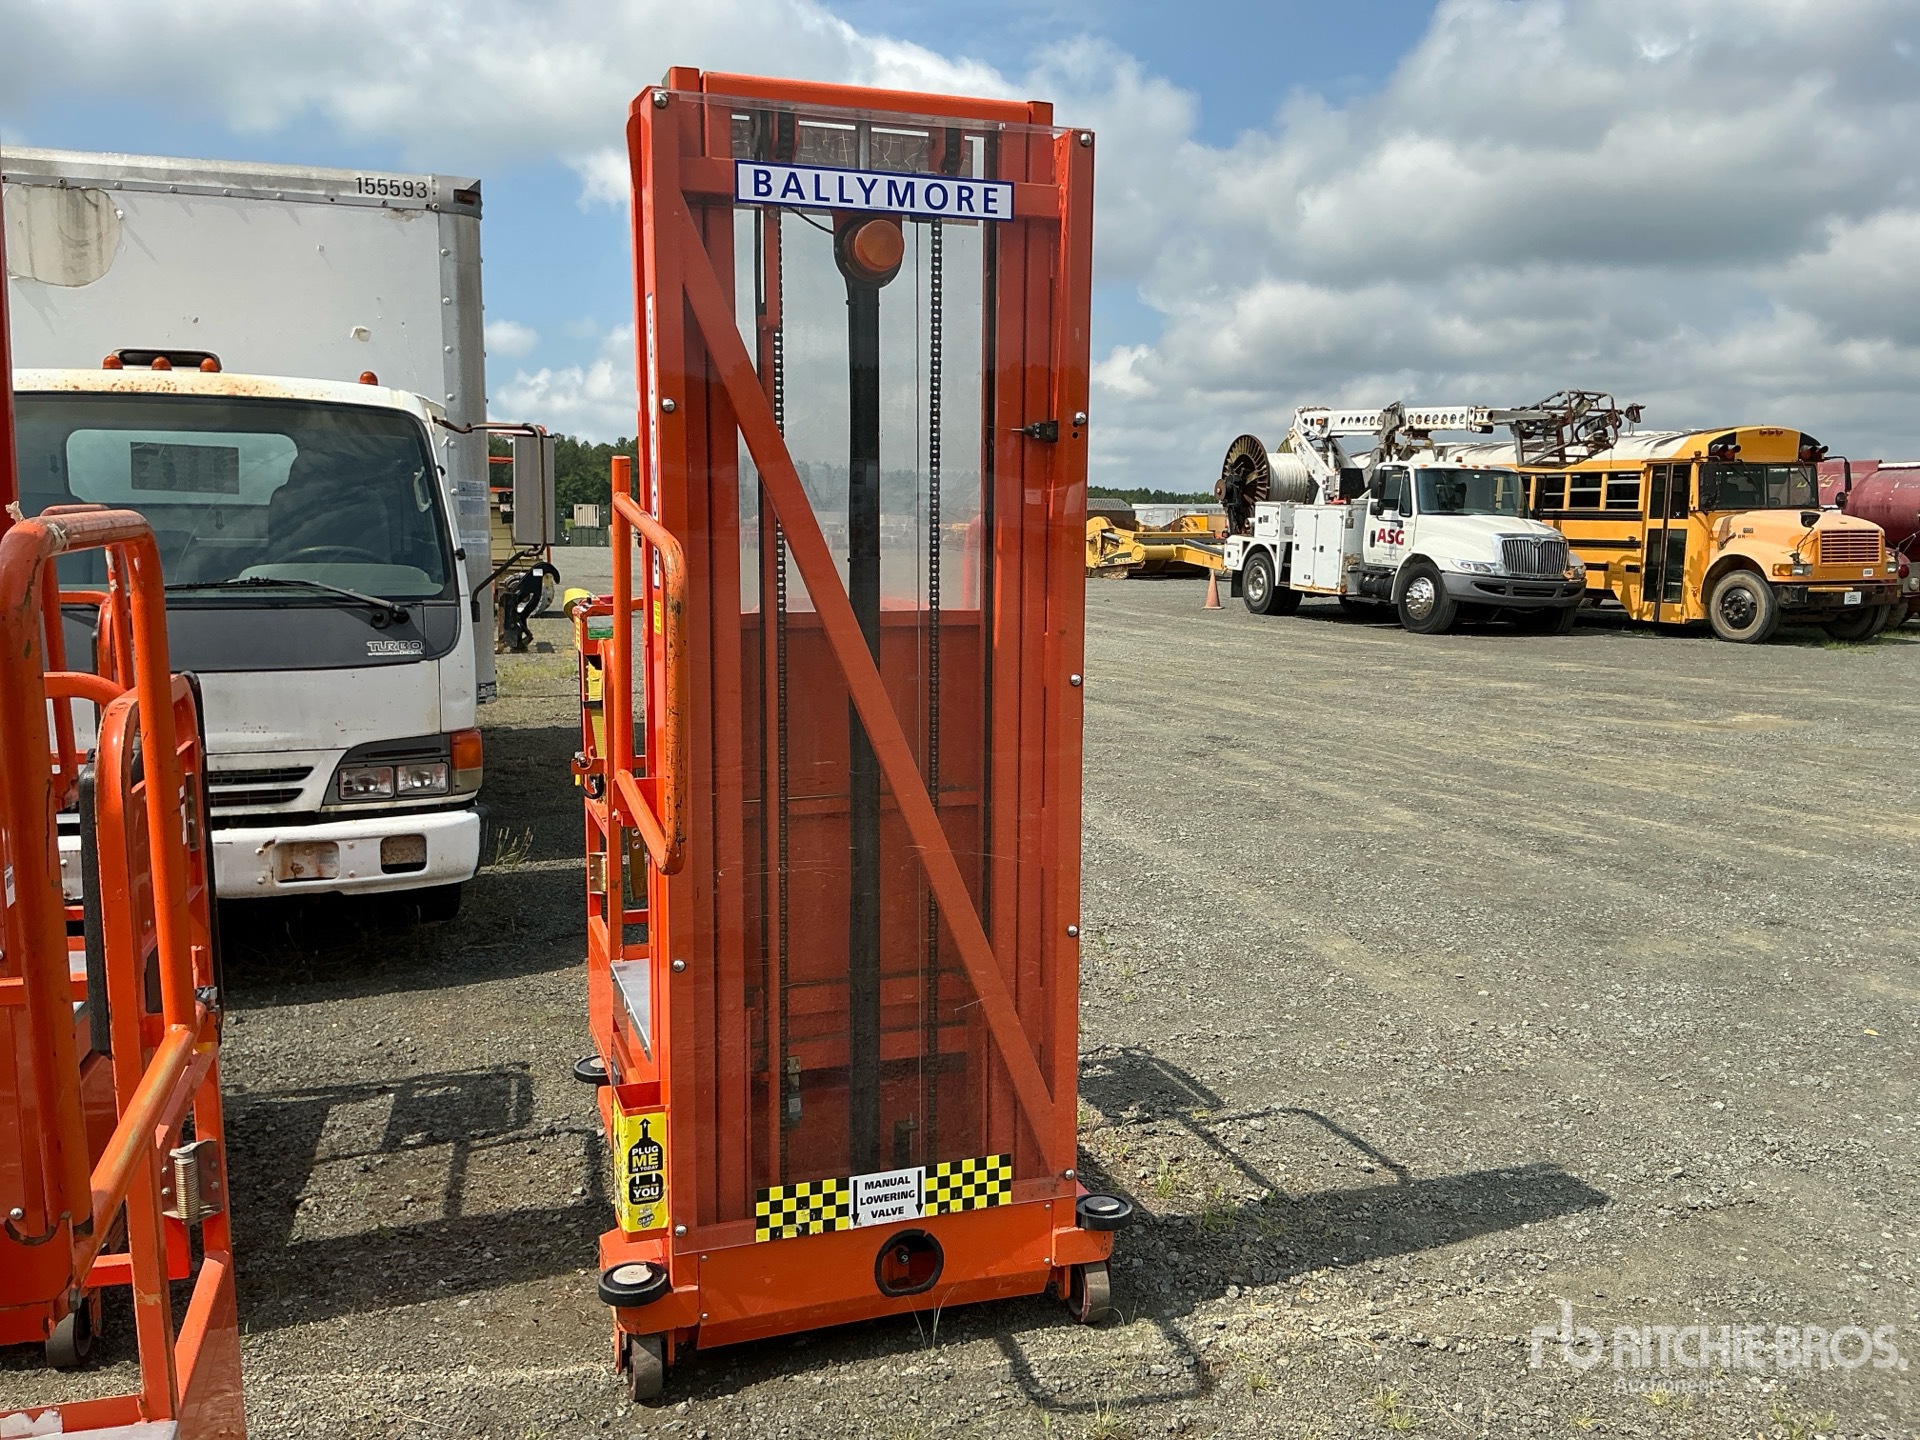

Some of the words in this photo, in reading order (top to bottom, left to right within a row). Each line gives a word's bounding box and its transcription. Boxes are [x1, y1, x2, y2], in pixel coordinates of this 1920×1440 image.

[356, 177, 428, 199] 155593
[753, 169, 999, 214] BALLYMORE
[1376, 528, 1405, 546] ASG
[366, 640, 423, 652] TURBO
[632, 1146, 658, 1155] PLUG
[632, 1153, 659, 1168] ME
[640, 1164, 659, 1172] TODAY
[864, 1175, 911, 1191] MANUAL
[633, 1186, 660, 1199] YOU
[860, 1189, 915, 1206] LOWERING
[871, 1206, 905, 1219] VALVE
